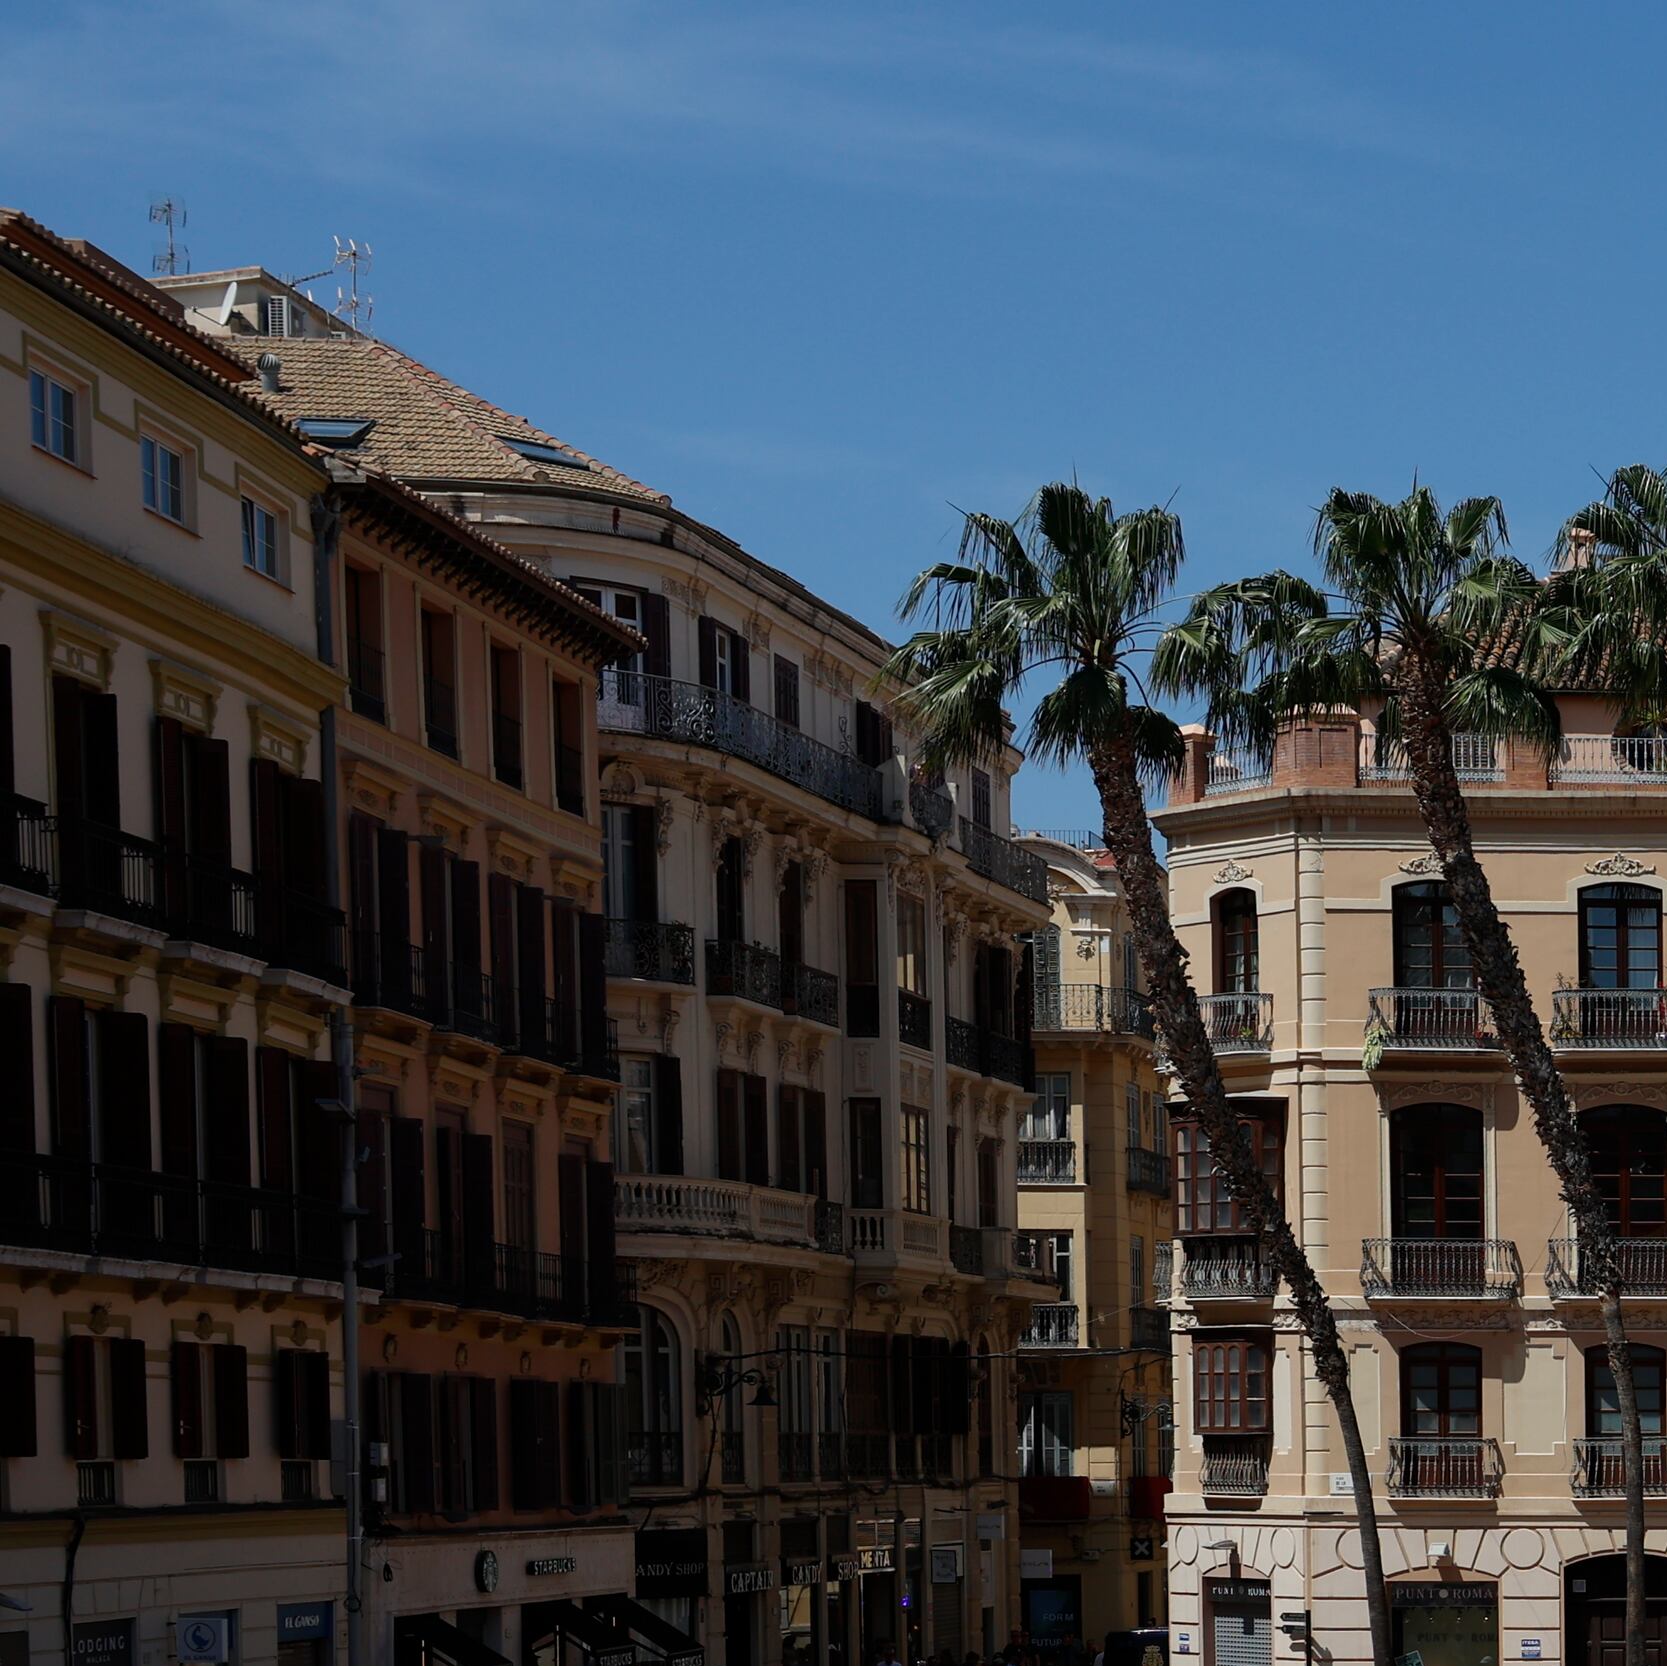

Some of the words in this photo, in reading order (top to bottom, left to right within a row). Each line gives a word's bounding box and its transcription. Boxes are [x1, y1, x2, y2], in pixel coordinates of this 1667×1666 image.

[534, 1557, 576, 1576] STARBUCKS
[635, 1561, 672, 1577] ANDY
[676, 1561, 704, 1576] SHOP
[861, 1549, 891, 1569] MENTA
[731, 1569, 774, 1592] CAPTAIN
[792, 1560, 823, 1584] CANDY
[838, 1561, 860, 1581] SHOP
[1452, 1587, 1494, 1600] ROMA
[72, 1635, 126, 1655] LODGING
